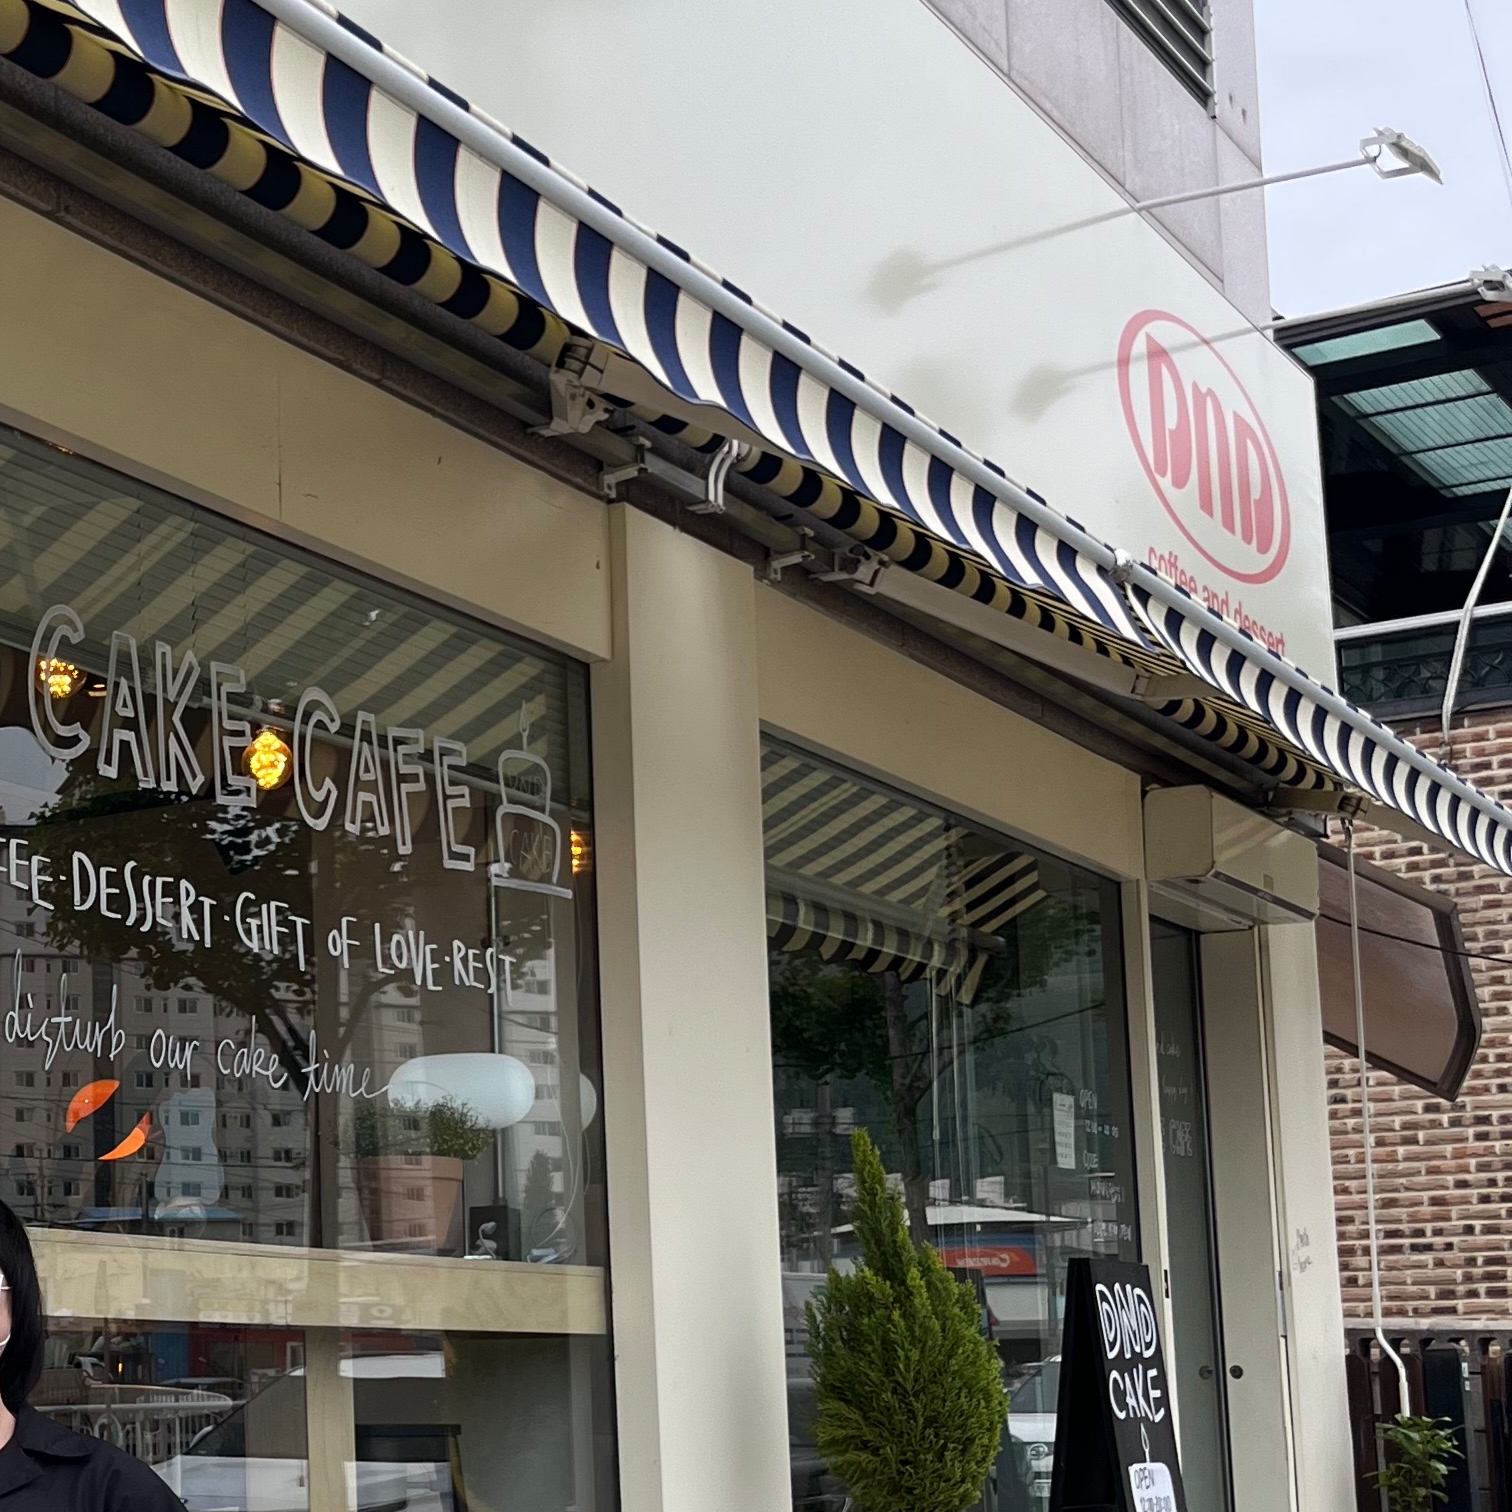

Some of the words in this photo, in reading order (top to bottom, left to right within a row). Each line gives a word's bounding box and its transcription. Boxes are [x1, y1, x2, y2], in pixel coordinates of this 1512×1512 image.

[1202, 584, 1230, 618] and
[27, 604, 257, 808] CAKE
[292, 686, 476, 871] CAFE
[5, 948, 126, 1071] disturb
[150, 1029, 200, 1080] our
[217, 1015, 288, 1088] cake
[301, 1030, 390, 1102] time
[1094, 1282, 1157, 1359] DND
[1109, 1363, 1165, 1423] CAKE
[1134, 1466, 1155, 1490] OPEN
